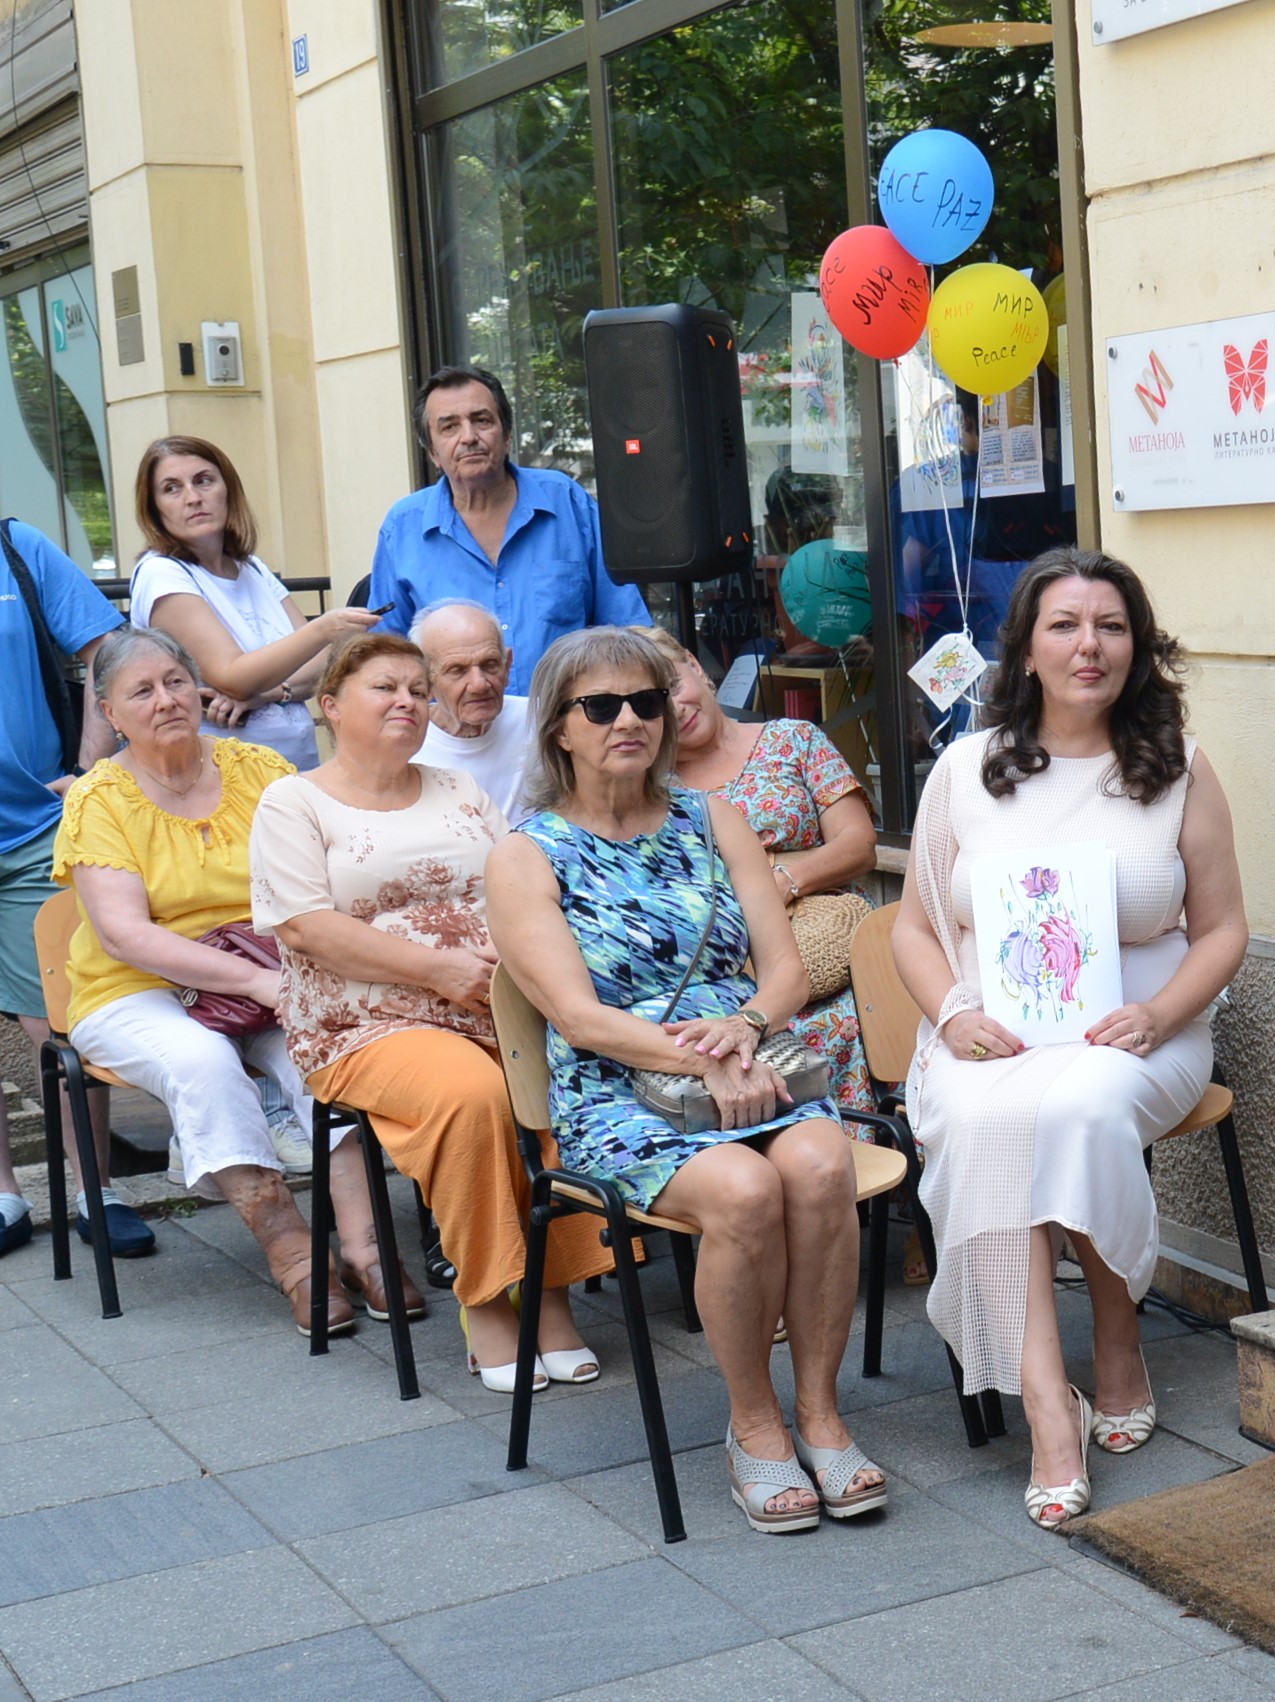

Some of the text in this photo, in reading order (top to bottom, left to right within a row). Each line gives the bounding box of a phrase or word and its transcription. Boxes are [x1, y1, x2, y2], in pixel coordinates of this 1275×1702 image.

[295, 40, 306, 70] 19
[881, 167, 982, 231] EACE PAZ
[972, 345, 1017, 367] Peace
[1128, 432, 1186, 453] МЕТАНОЈА
